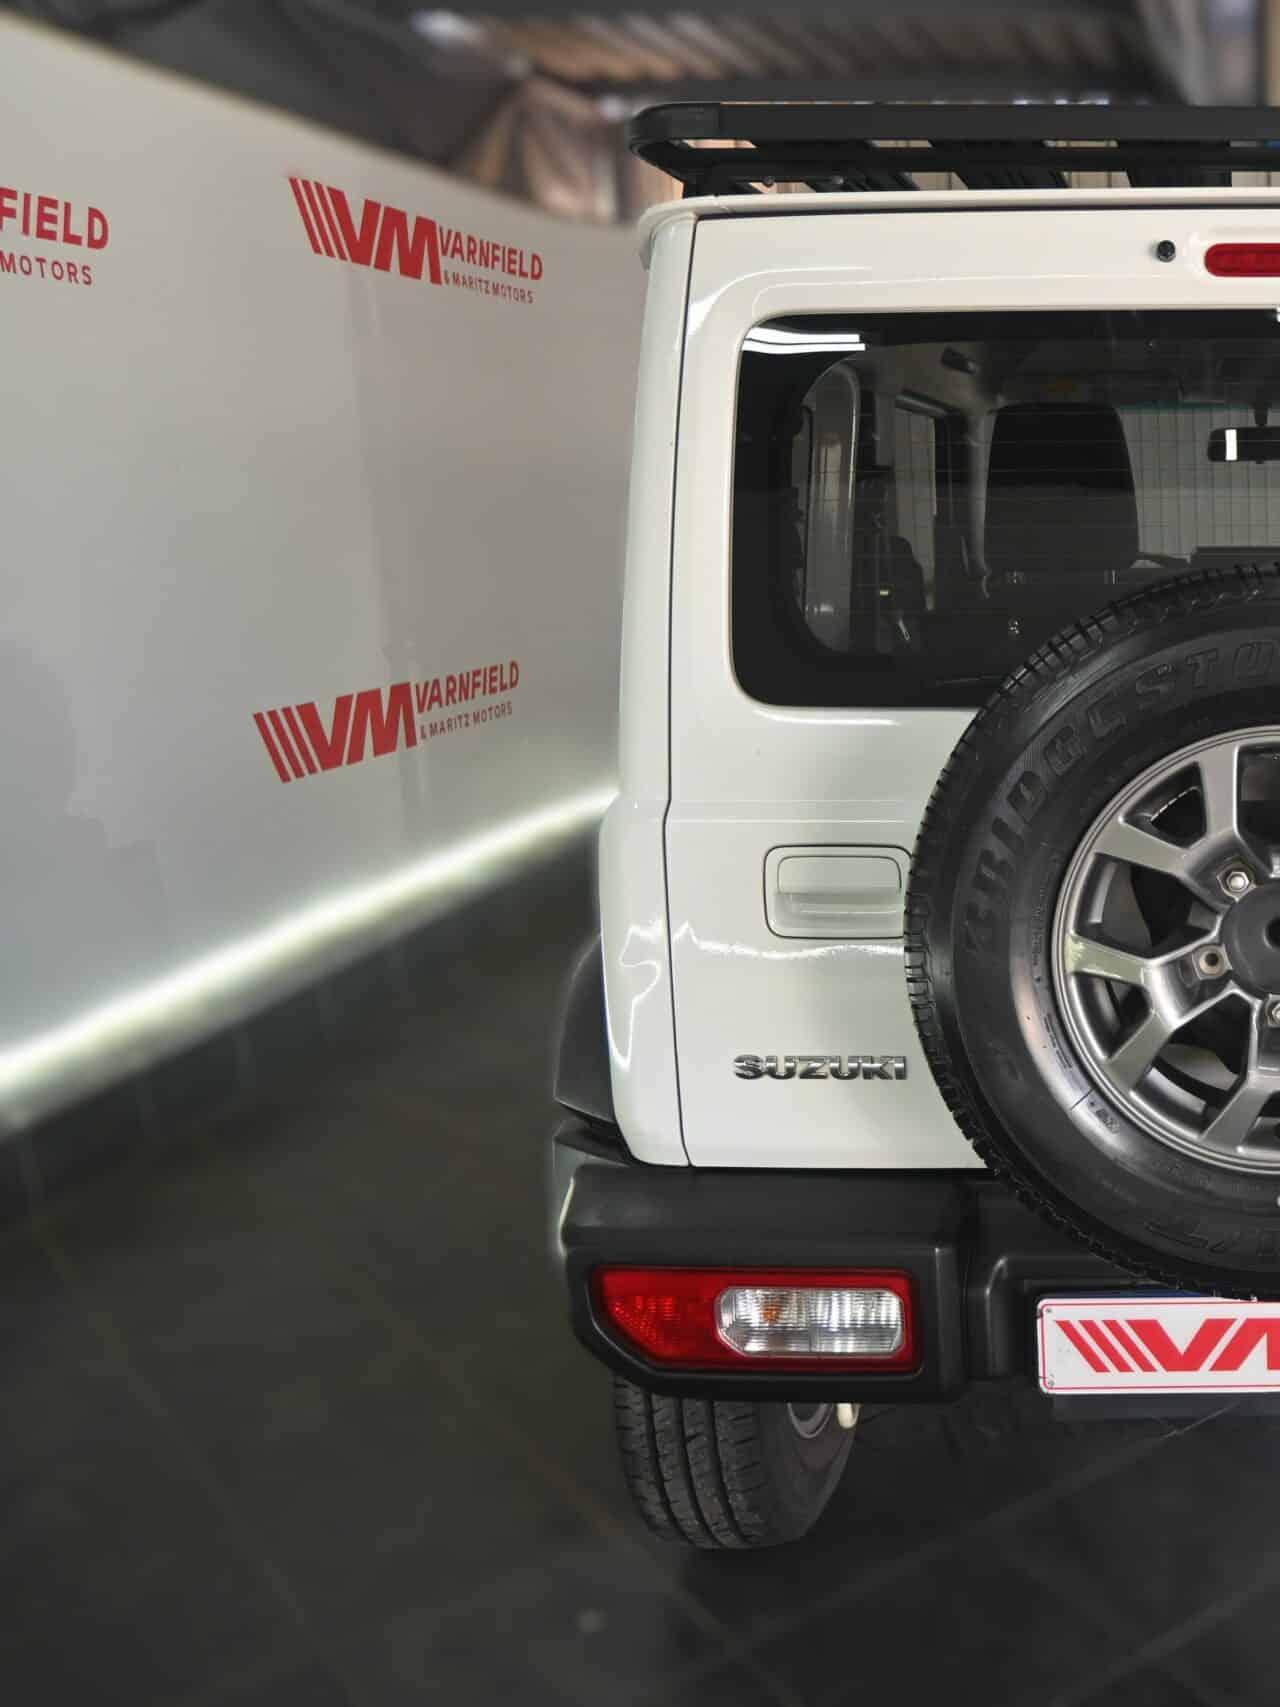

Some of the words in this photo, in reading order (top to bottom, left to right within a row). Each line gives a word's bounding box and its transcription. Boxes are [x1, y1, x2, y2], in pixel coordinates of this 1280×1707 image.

[0, 187, 109, 250] FIELD
[0, 250, 92, 286] MOTORS
[439, 225, 543, 281] VARNFIELD
[453, 272, 490, 295] MARITZ
[492, 282, 534, 304] MOTORS
[415, 660, 519, 714] VARNFIELD
[420, 725, 427, 740] &
[429, 713, 470, 738] MARITZ
[472, 700, 512, 729] MOTORS
[734, 1054, 907, 1080] SUZUKI
